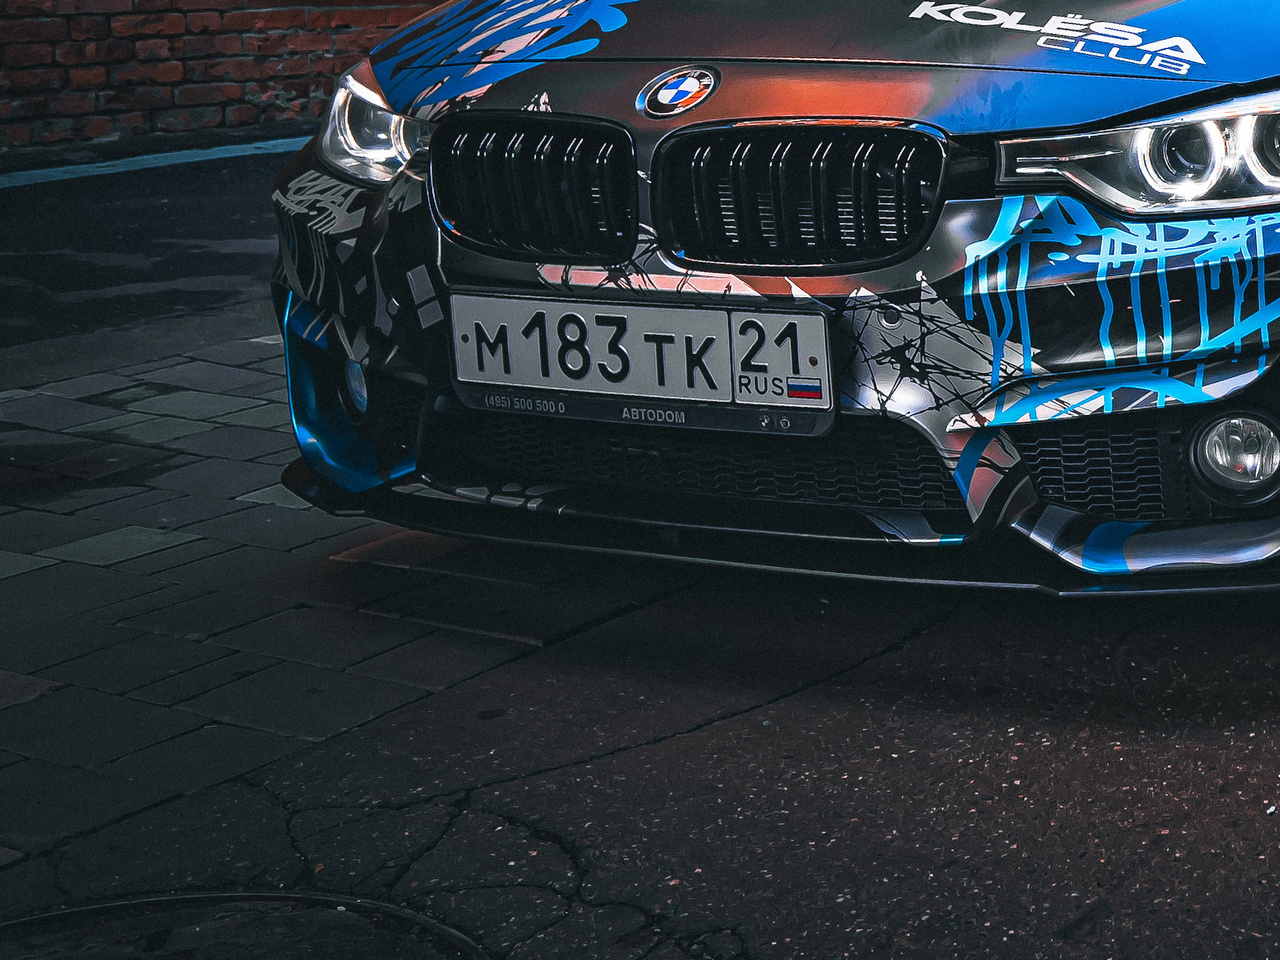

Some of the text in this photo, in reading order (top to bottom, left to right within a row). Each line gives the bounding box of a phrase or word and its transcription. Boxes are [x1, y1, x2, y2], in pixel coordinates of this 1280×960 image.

[1036, 36, 1190, 75] CLUB
[739, 319, 799, 375] 21
[739, 375, 784, 395] RUS
[485, 395, 511, 409] (495)
[513, 398, 534, 411] 500
[536, 400, 556, 414] 500
